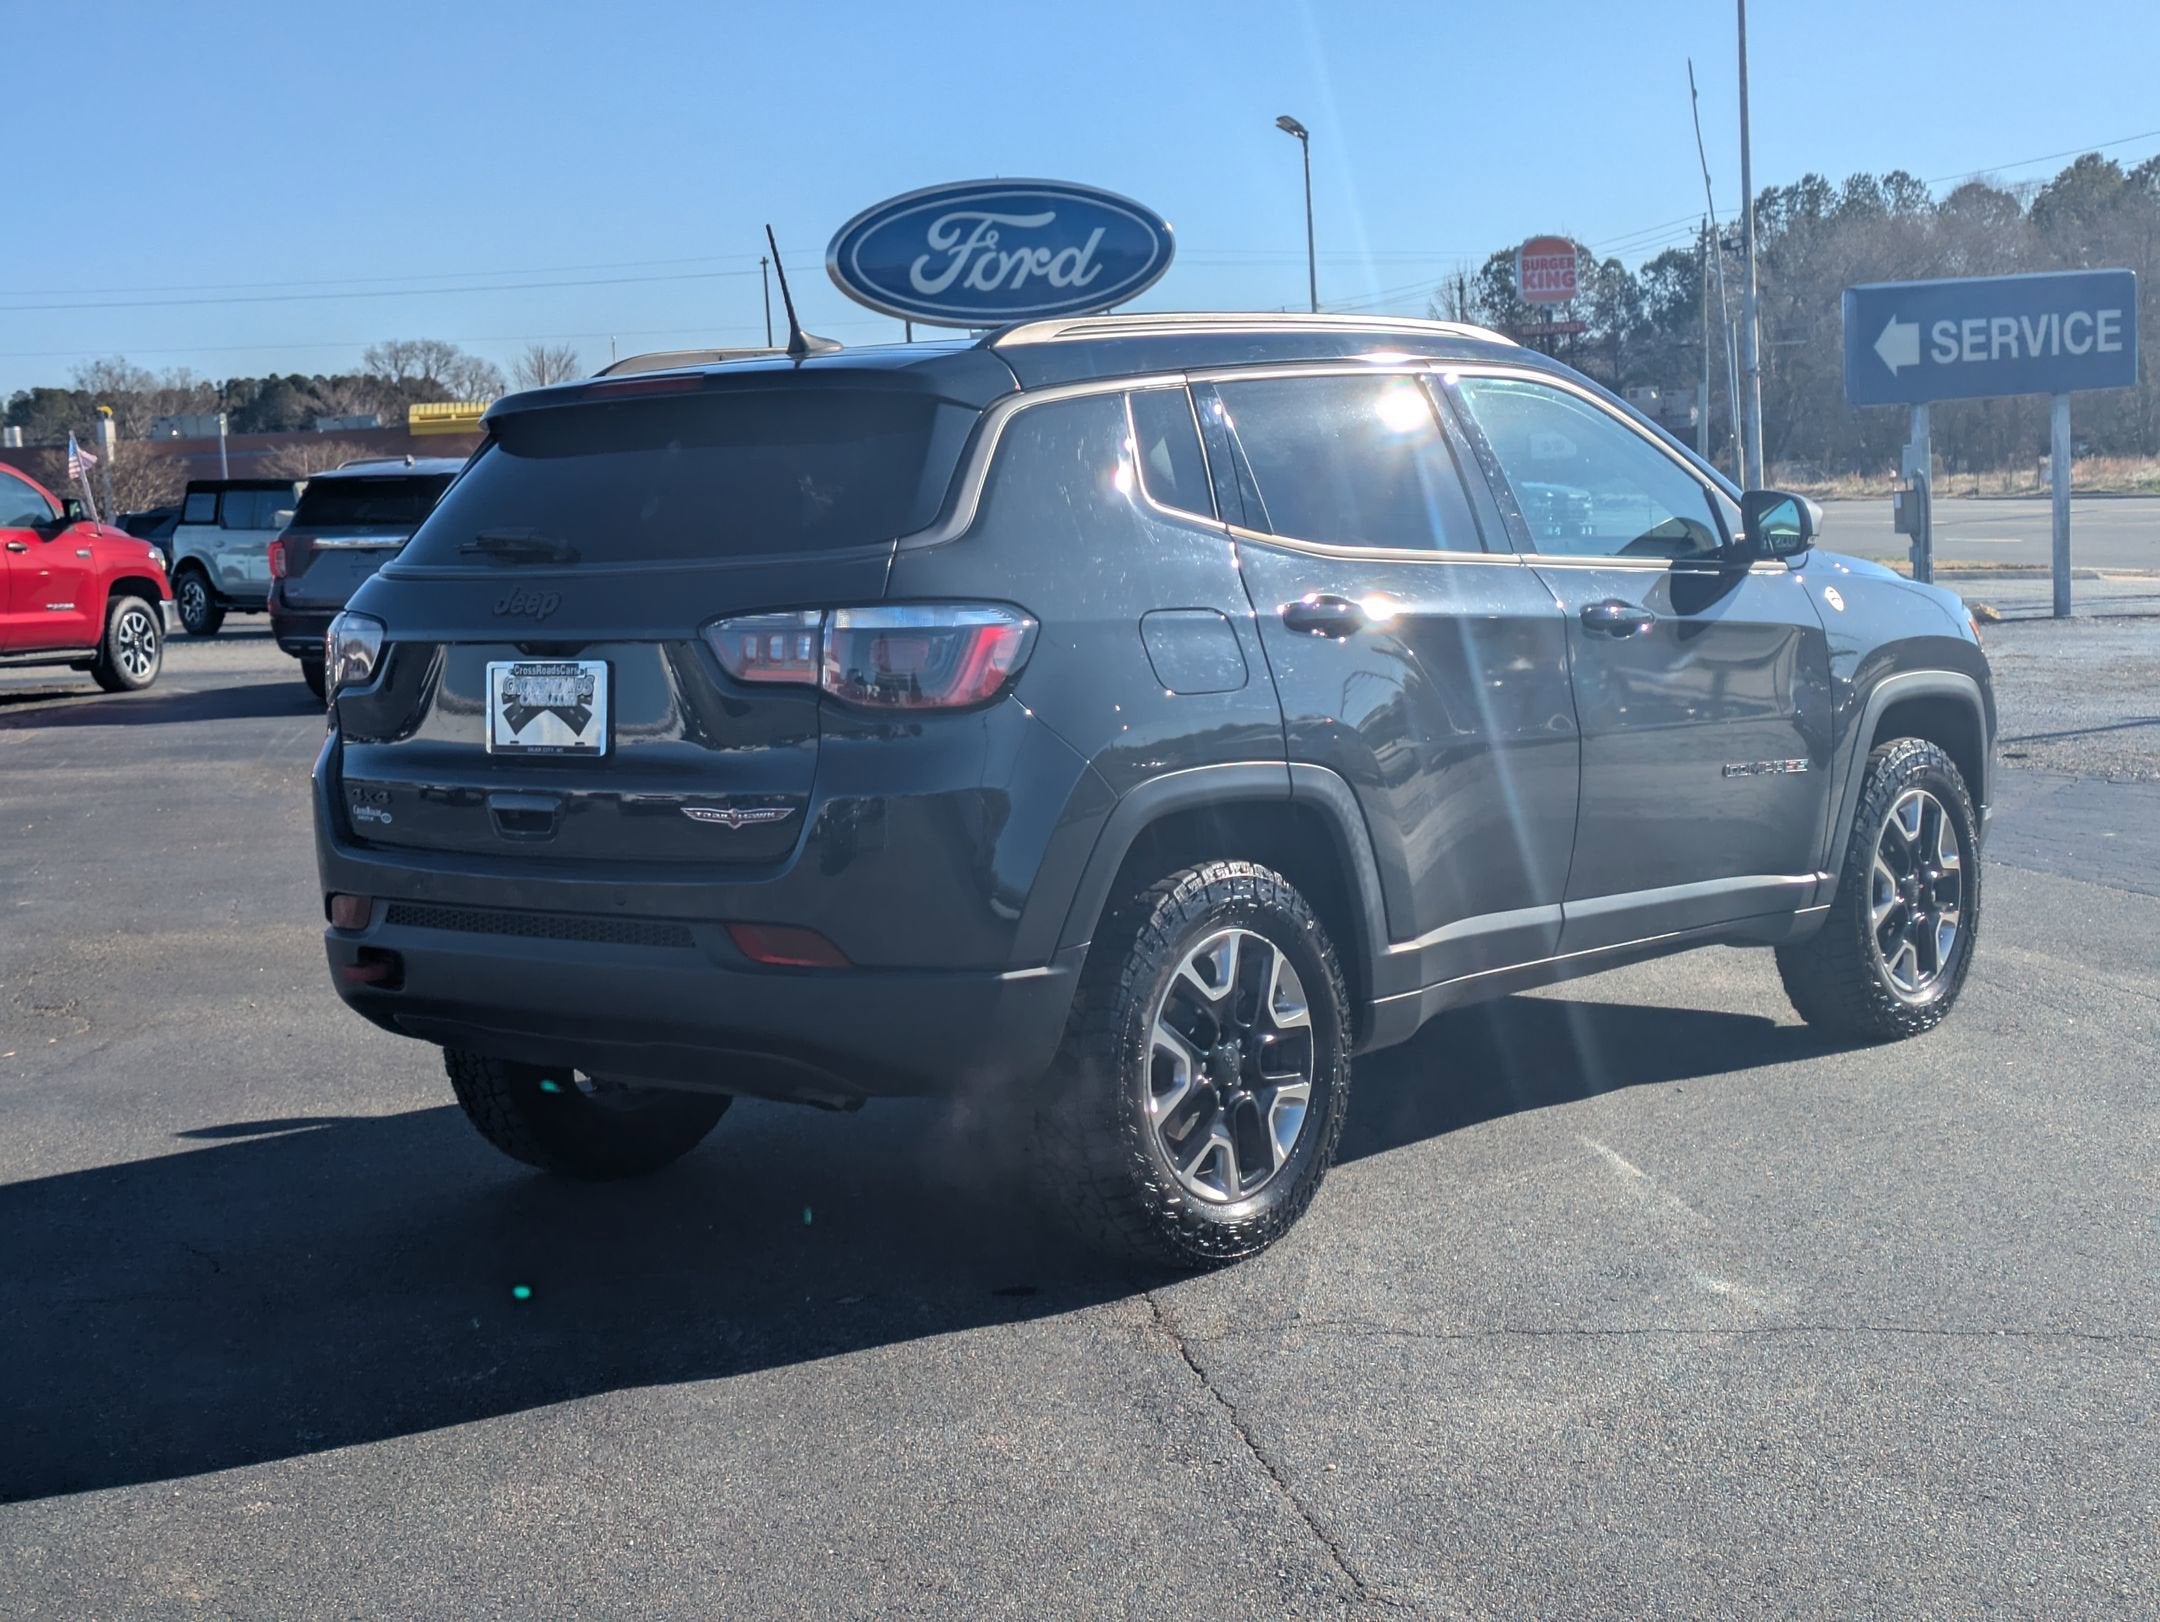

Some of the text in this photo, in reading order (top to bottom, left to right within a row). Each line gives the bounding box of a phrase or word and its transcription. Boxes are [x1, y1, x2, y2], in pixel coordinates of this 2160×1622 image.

[910, 211, 1106, 295] Ford
[1522, 257, 1575, 272] BURGER
[1522, 270, 1576, 290] KING
[1930, 309, 2122, 364] SERVICE
[493, 584, 561, 619] Jeep
